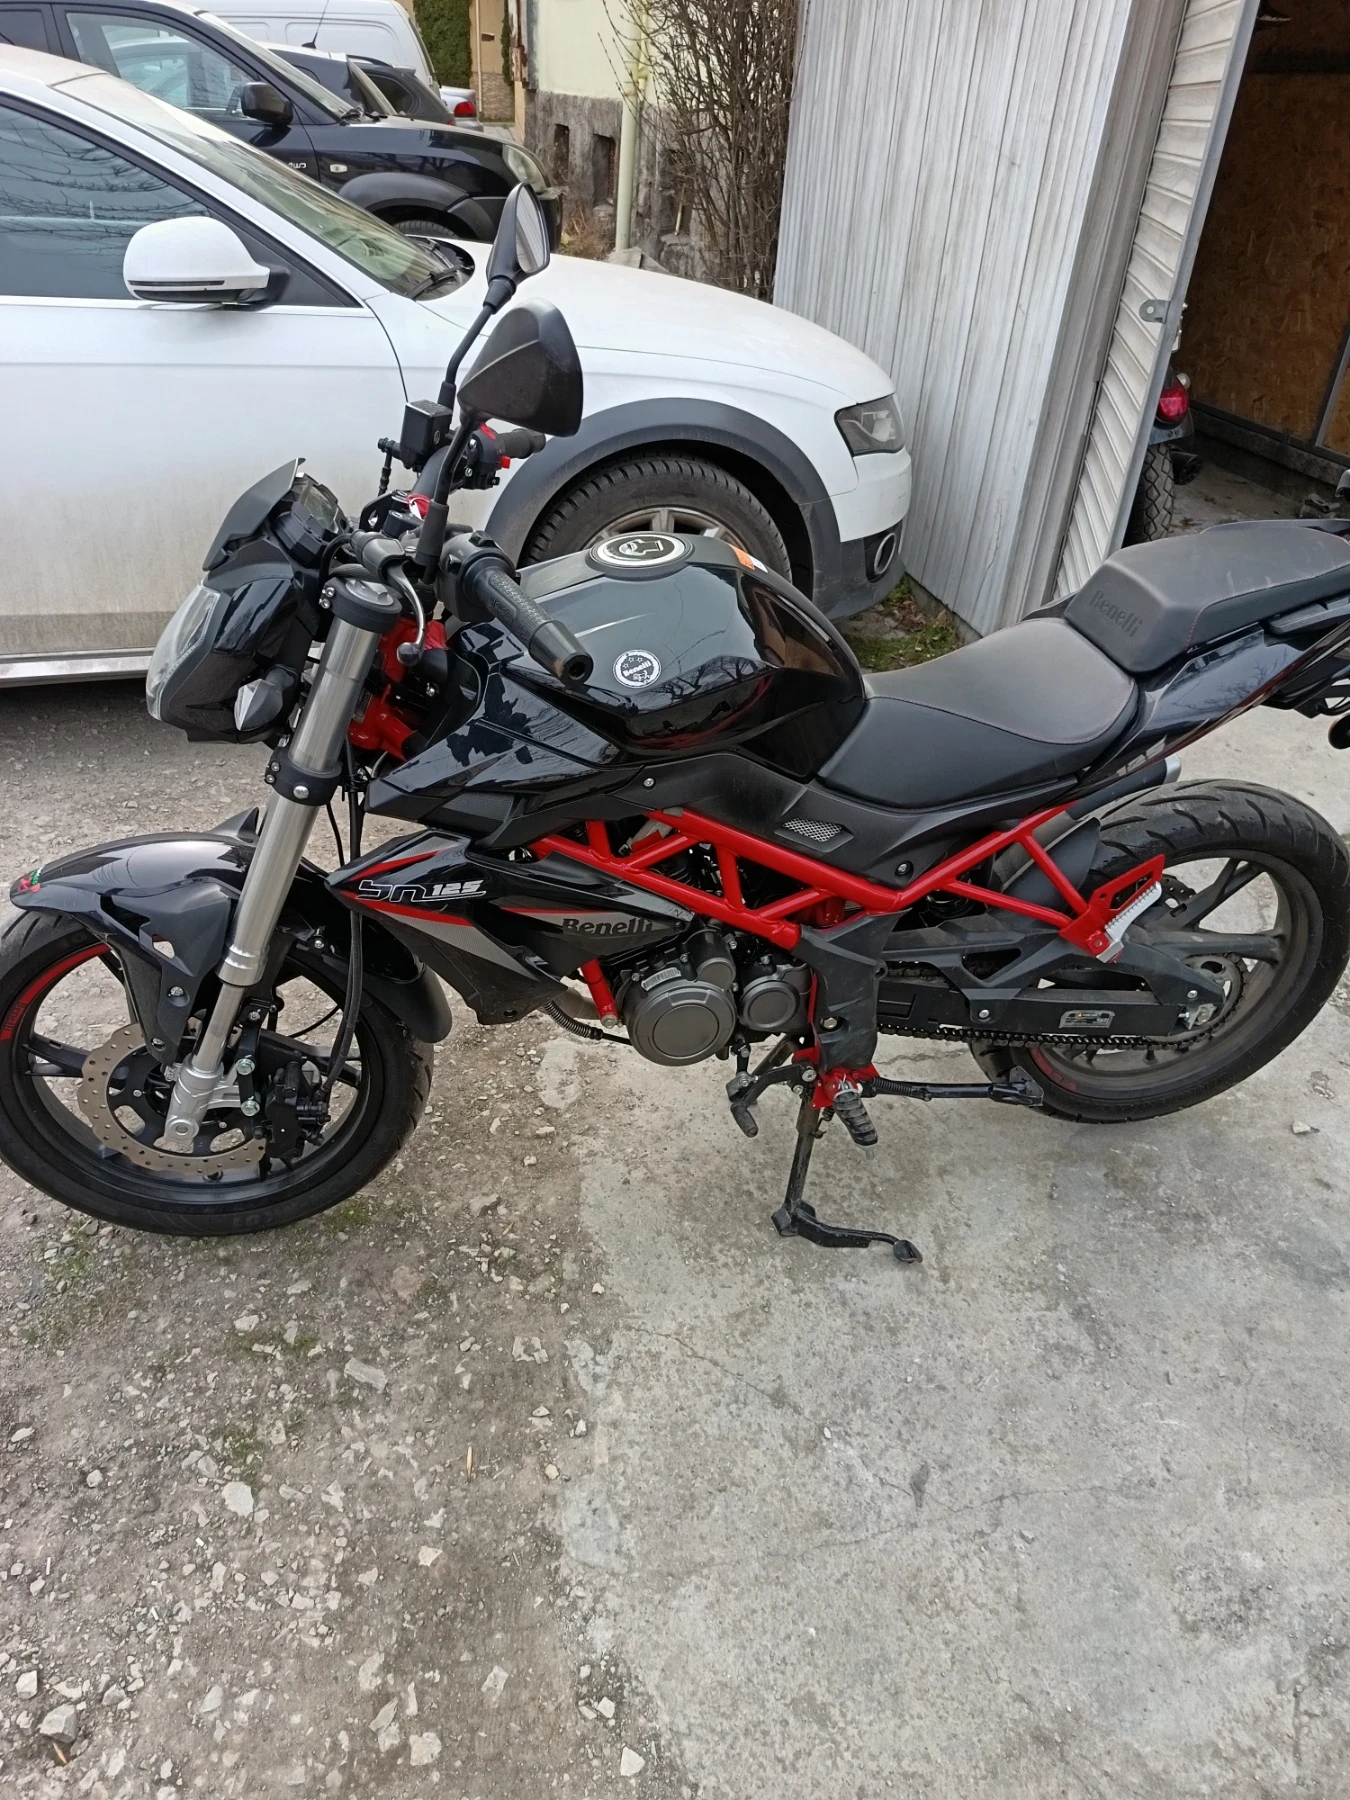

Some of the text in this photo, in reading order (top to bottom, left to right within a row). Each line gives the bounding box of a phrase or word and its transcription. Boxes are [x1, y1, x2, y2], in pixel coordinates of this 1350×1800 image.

[1088, 590, 1143, 638] Benelli
[622, 660, 652, 677] Benelli
[562, 918, 654, 935] Benelli
